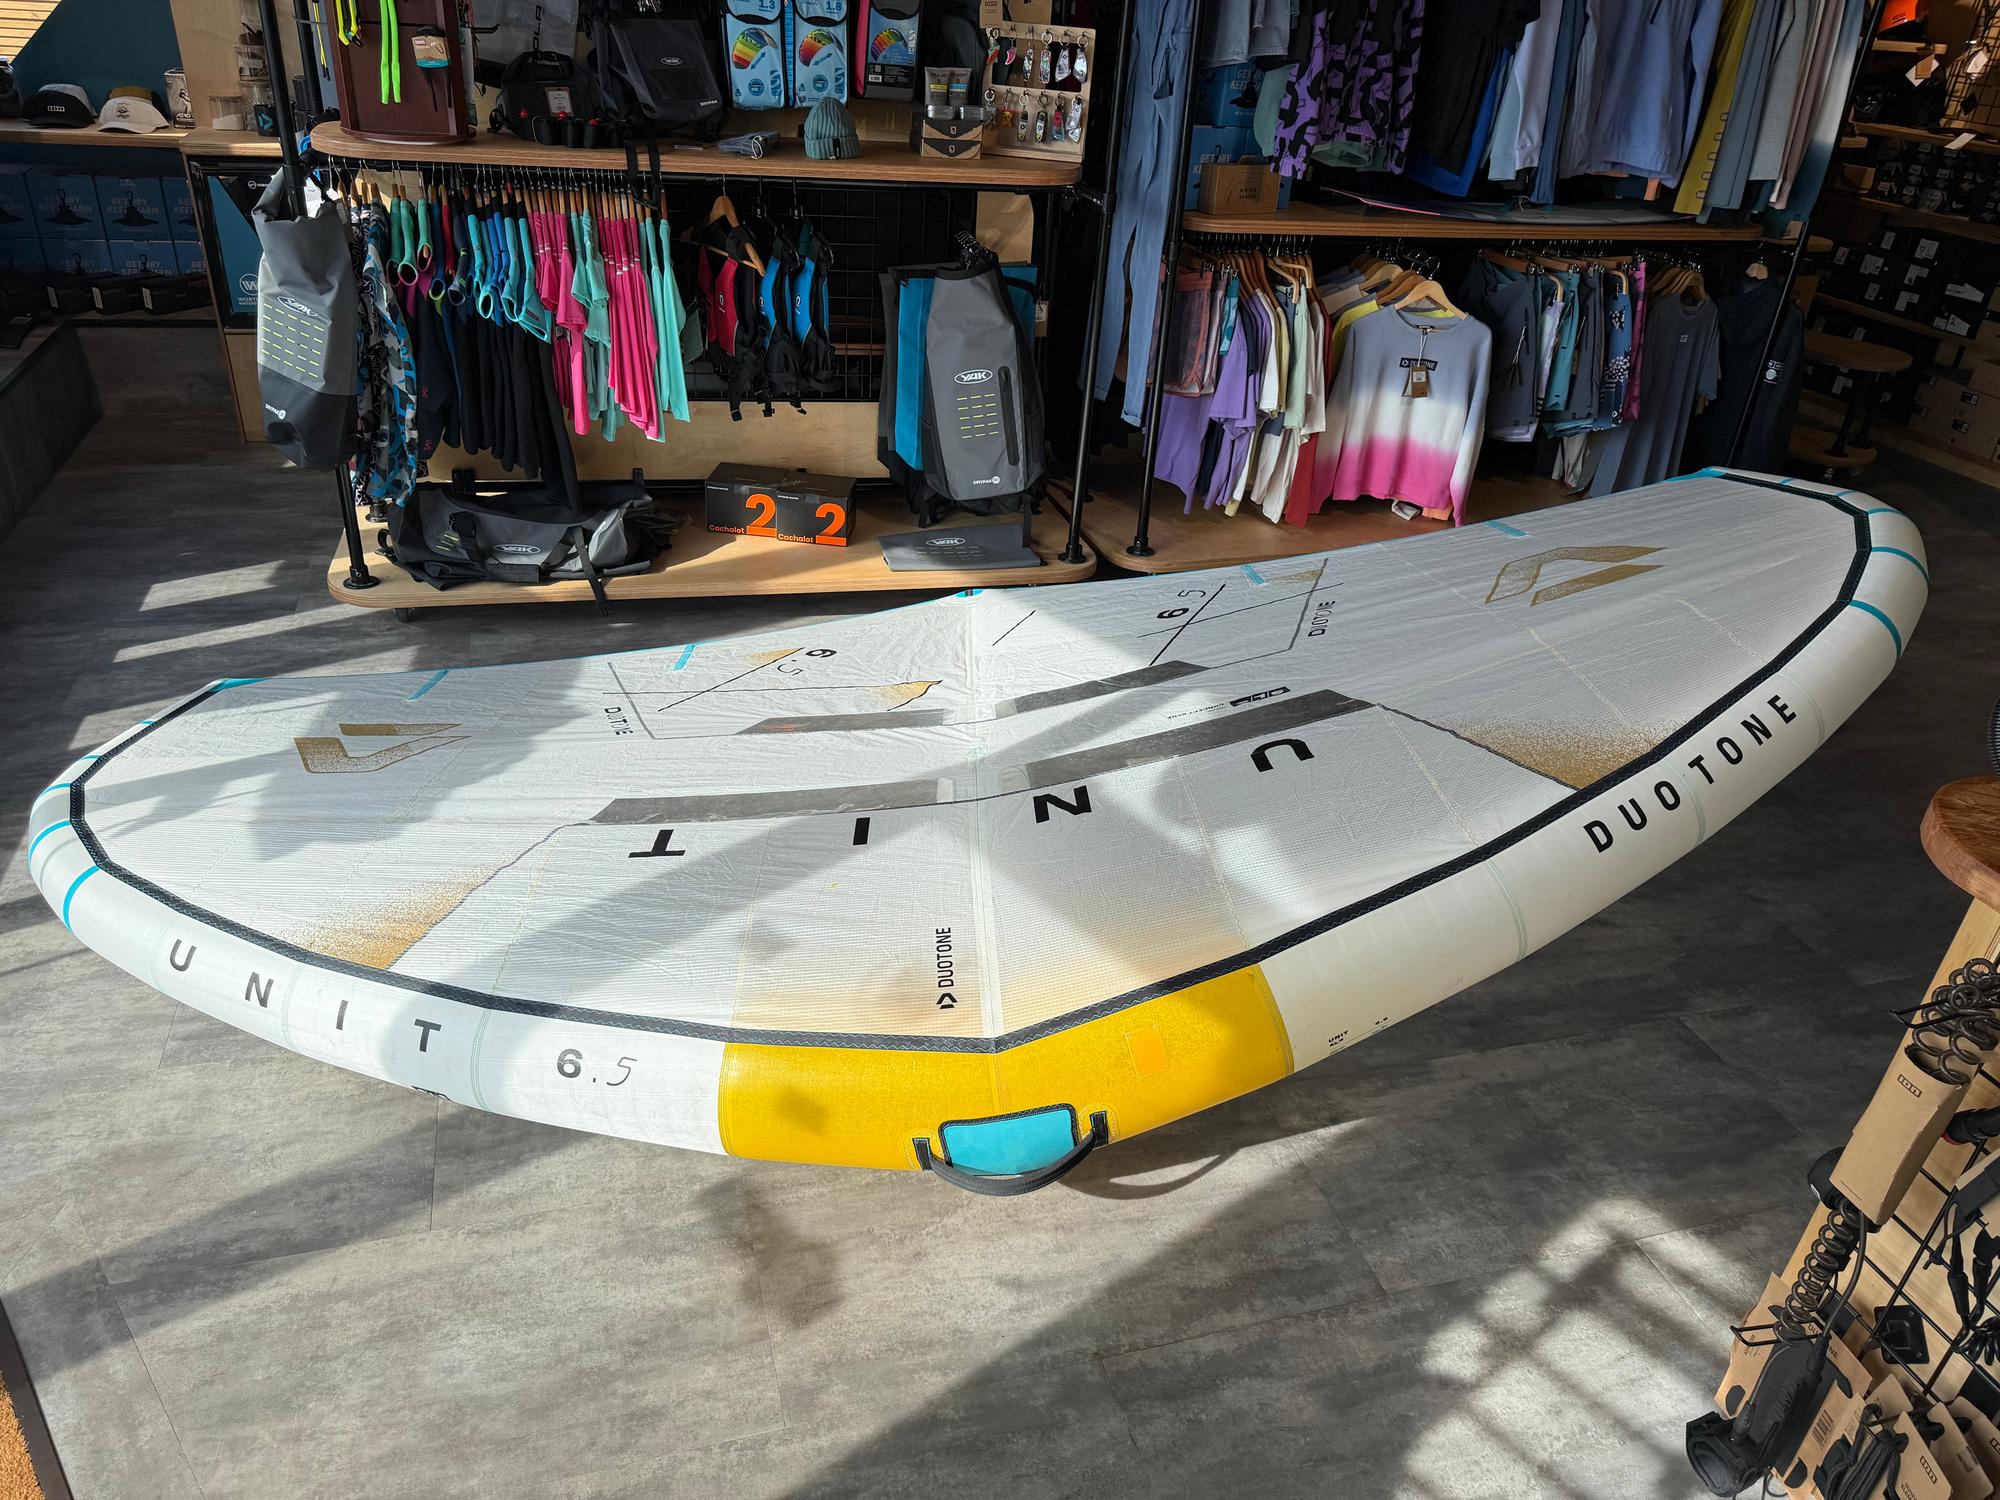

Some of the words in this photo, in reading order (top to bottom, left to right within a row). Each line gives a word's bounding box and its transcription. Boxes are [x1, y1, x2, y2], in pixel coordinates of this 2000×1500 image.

[826, 1, 842, 10] 1.8
[961, 371, 987, 380] YAK
[708, 524, 745, 534] Cachalot
[745, 493, 777, 538] 2
[815, 502, 847, 546] 2
[777, 533, 814, 543] Cachalot
[1583, 694, 1798, 853] DUOTONE
[936, 927, 955, 988] DUOTONE
[169, 938, 442, 1053] UNIT
[556, 1048, 638, 1087] 6.5
[1807, 1323, 1840, 1360] DUNE
